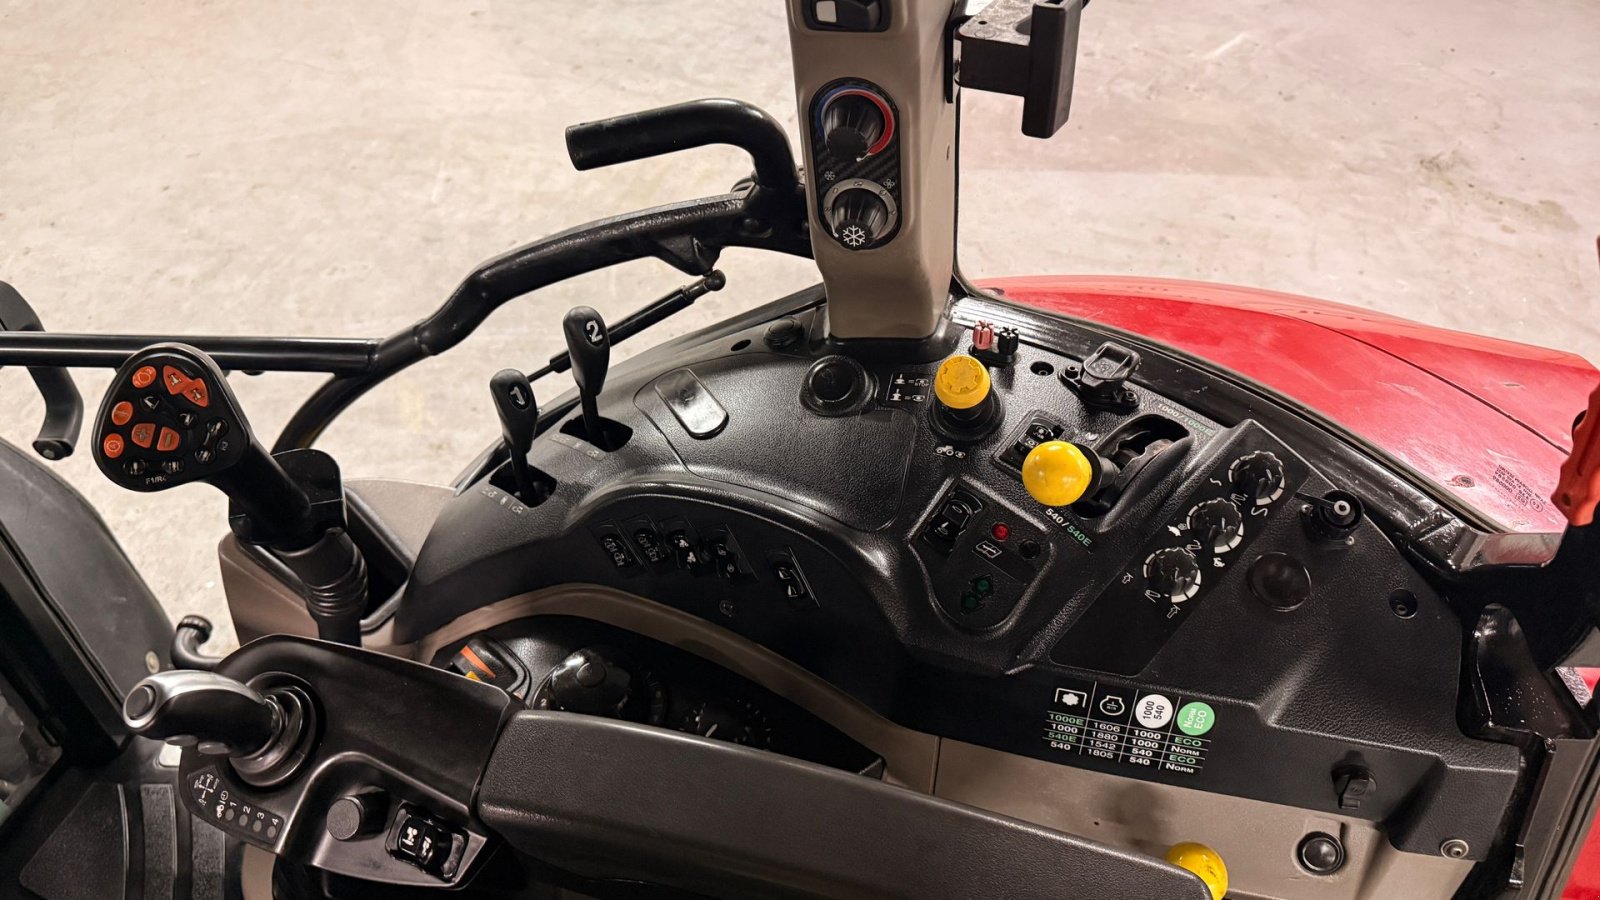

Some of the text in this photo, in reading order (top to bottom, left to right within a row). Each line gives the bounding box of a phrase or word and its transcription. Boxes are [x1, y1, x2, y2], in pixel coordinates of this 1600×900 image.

[586, 320, 603, 343] 2
[510, 386, 526, 406] 1
[1142, 700, 1155, 720] 1000
[1153, 705, 1165, 720] 540
[1194, 710, 1207, 730] ECO
[1049, 713, 1202, 747] 1000E 1606 1000 ECO
[1051, 723, 1079, 734] 1000
[1091, 731, 1119, 742] 1880
[1131, 738, 1159, 749] 1000
[1047, 732, 1196, 765] 540E 1542 540 ECO
[1050, 741, 1071, 751] 540
[1087, 748, 1114, 759] 1805
[1129, 756, 1151, 766] 540
[243, 806, 251, 814] 2
[256, 811, 265, 820] 3
[271, 817, 279, 826] 4
